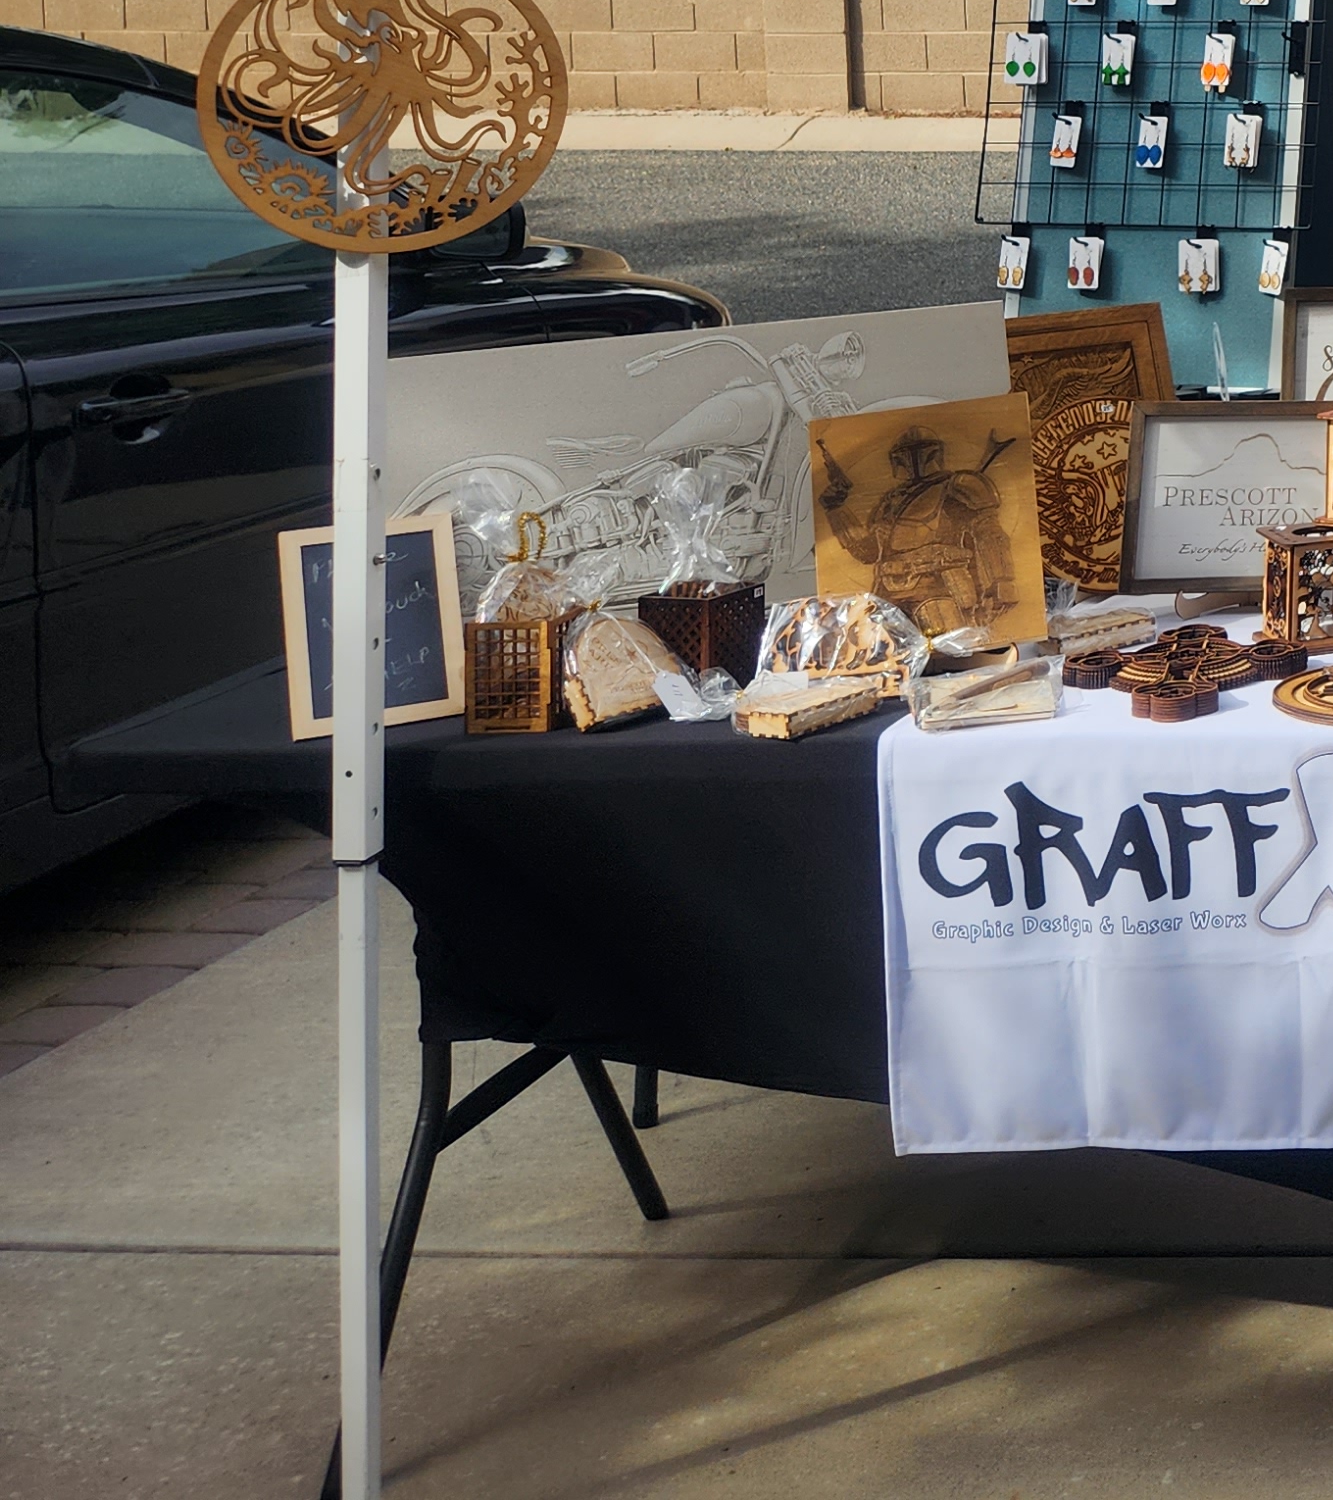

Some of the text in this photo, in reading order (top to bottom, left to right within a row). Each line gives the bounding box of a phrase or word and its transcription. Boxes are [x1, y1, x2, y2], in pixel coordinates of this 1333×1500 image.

[1162, 486, 1297, 507] PRESCOTT
[1219, 506, 1318, 527] ARIZON
[932, 910, 1247, 944] Graphic Design & Laser Worx
